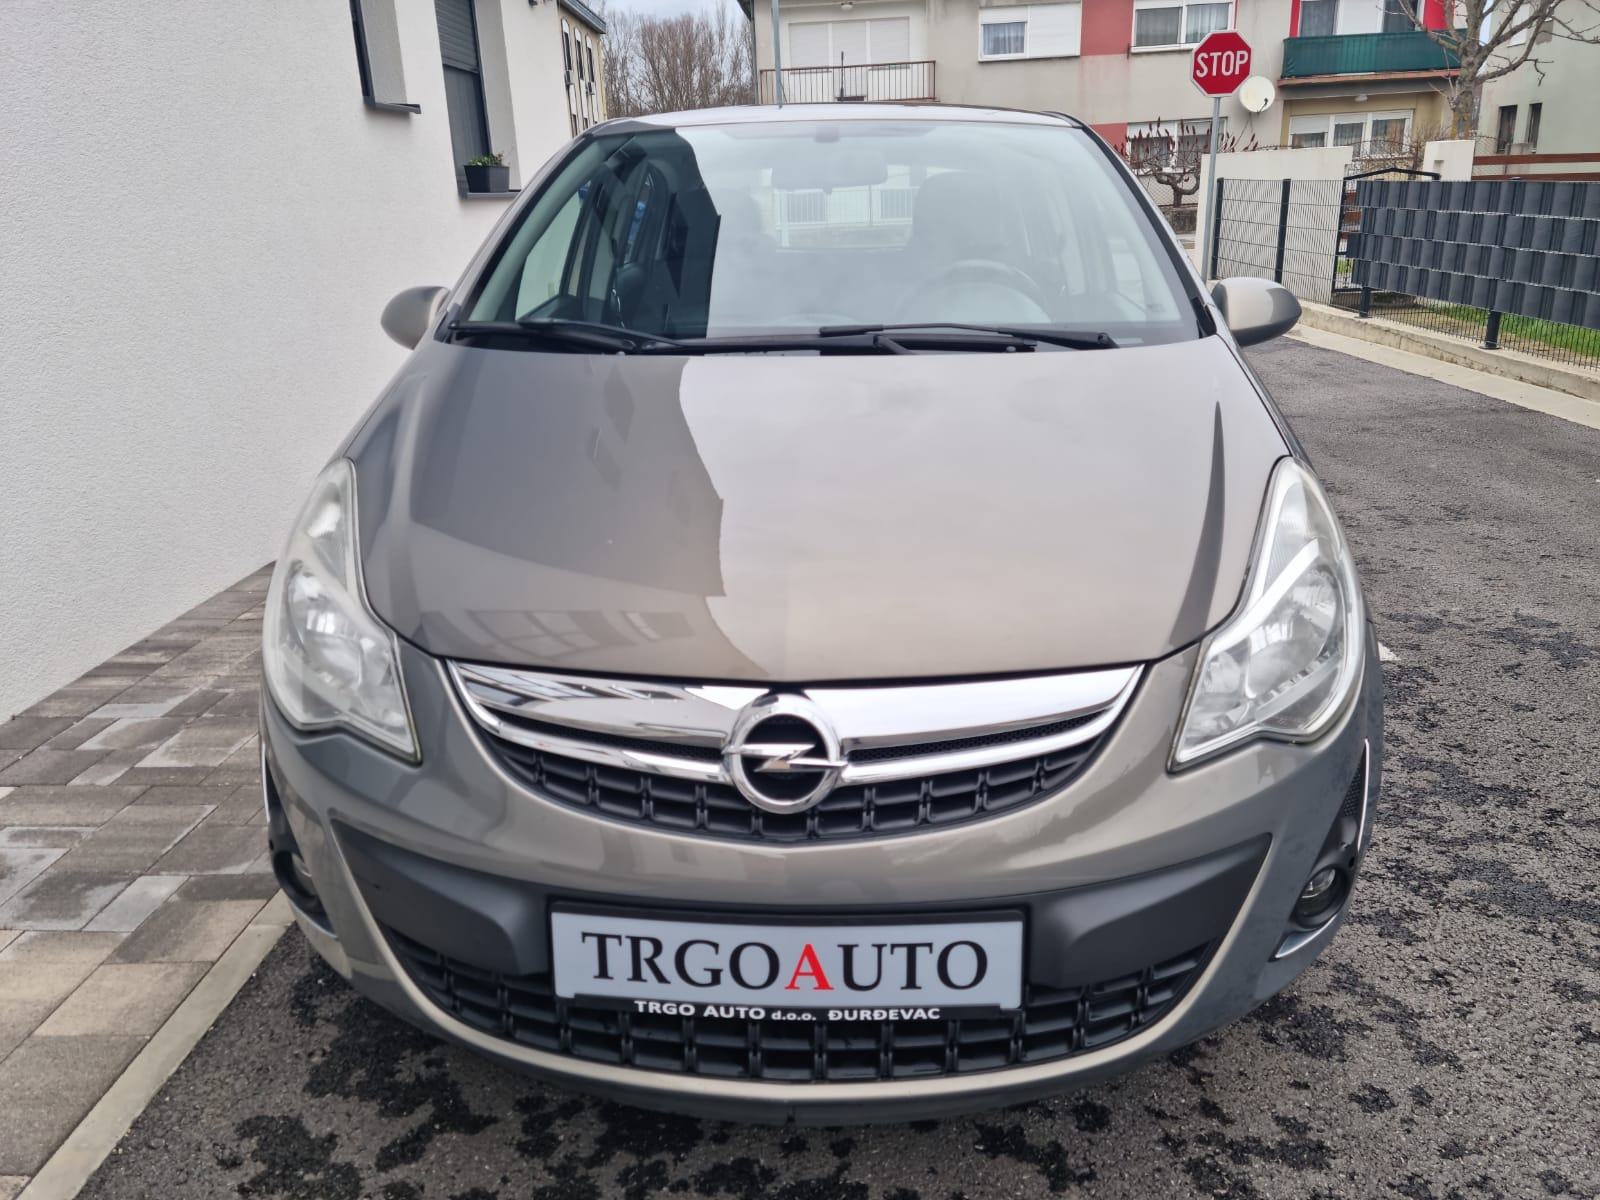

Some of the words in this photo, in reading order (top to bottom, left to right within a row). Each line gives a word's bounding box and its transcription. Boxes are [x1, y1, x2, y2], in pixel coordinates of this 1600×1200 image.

[1196, 50, 1248, 78] STOP
[581, 931, 989, 992] TRGOAUTO
[634, 1000, 696, 1016] TRGO
[703, 1005, 766, 1020] AUTO
[771, 1009, 817, 1021] d.o.o.
[827, 1008, 941, 1021] ĐURĐEVAC
